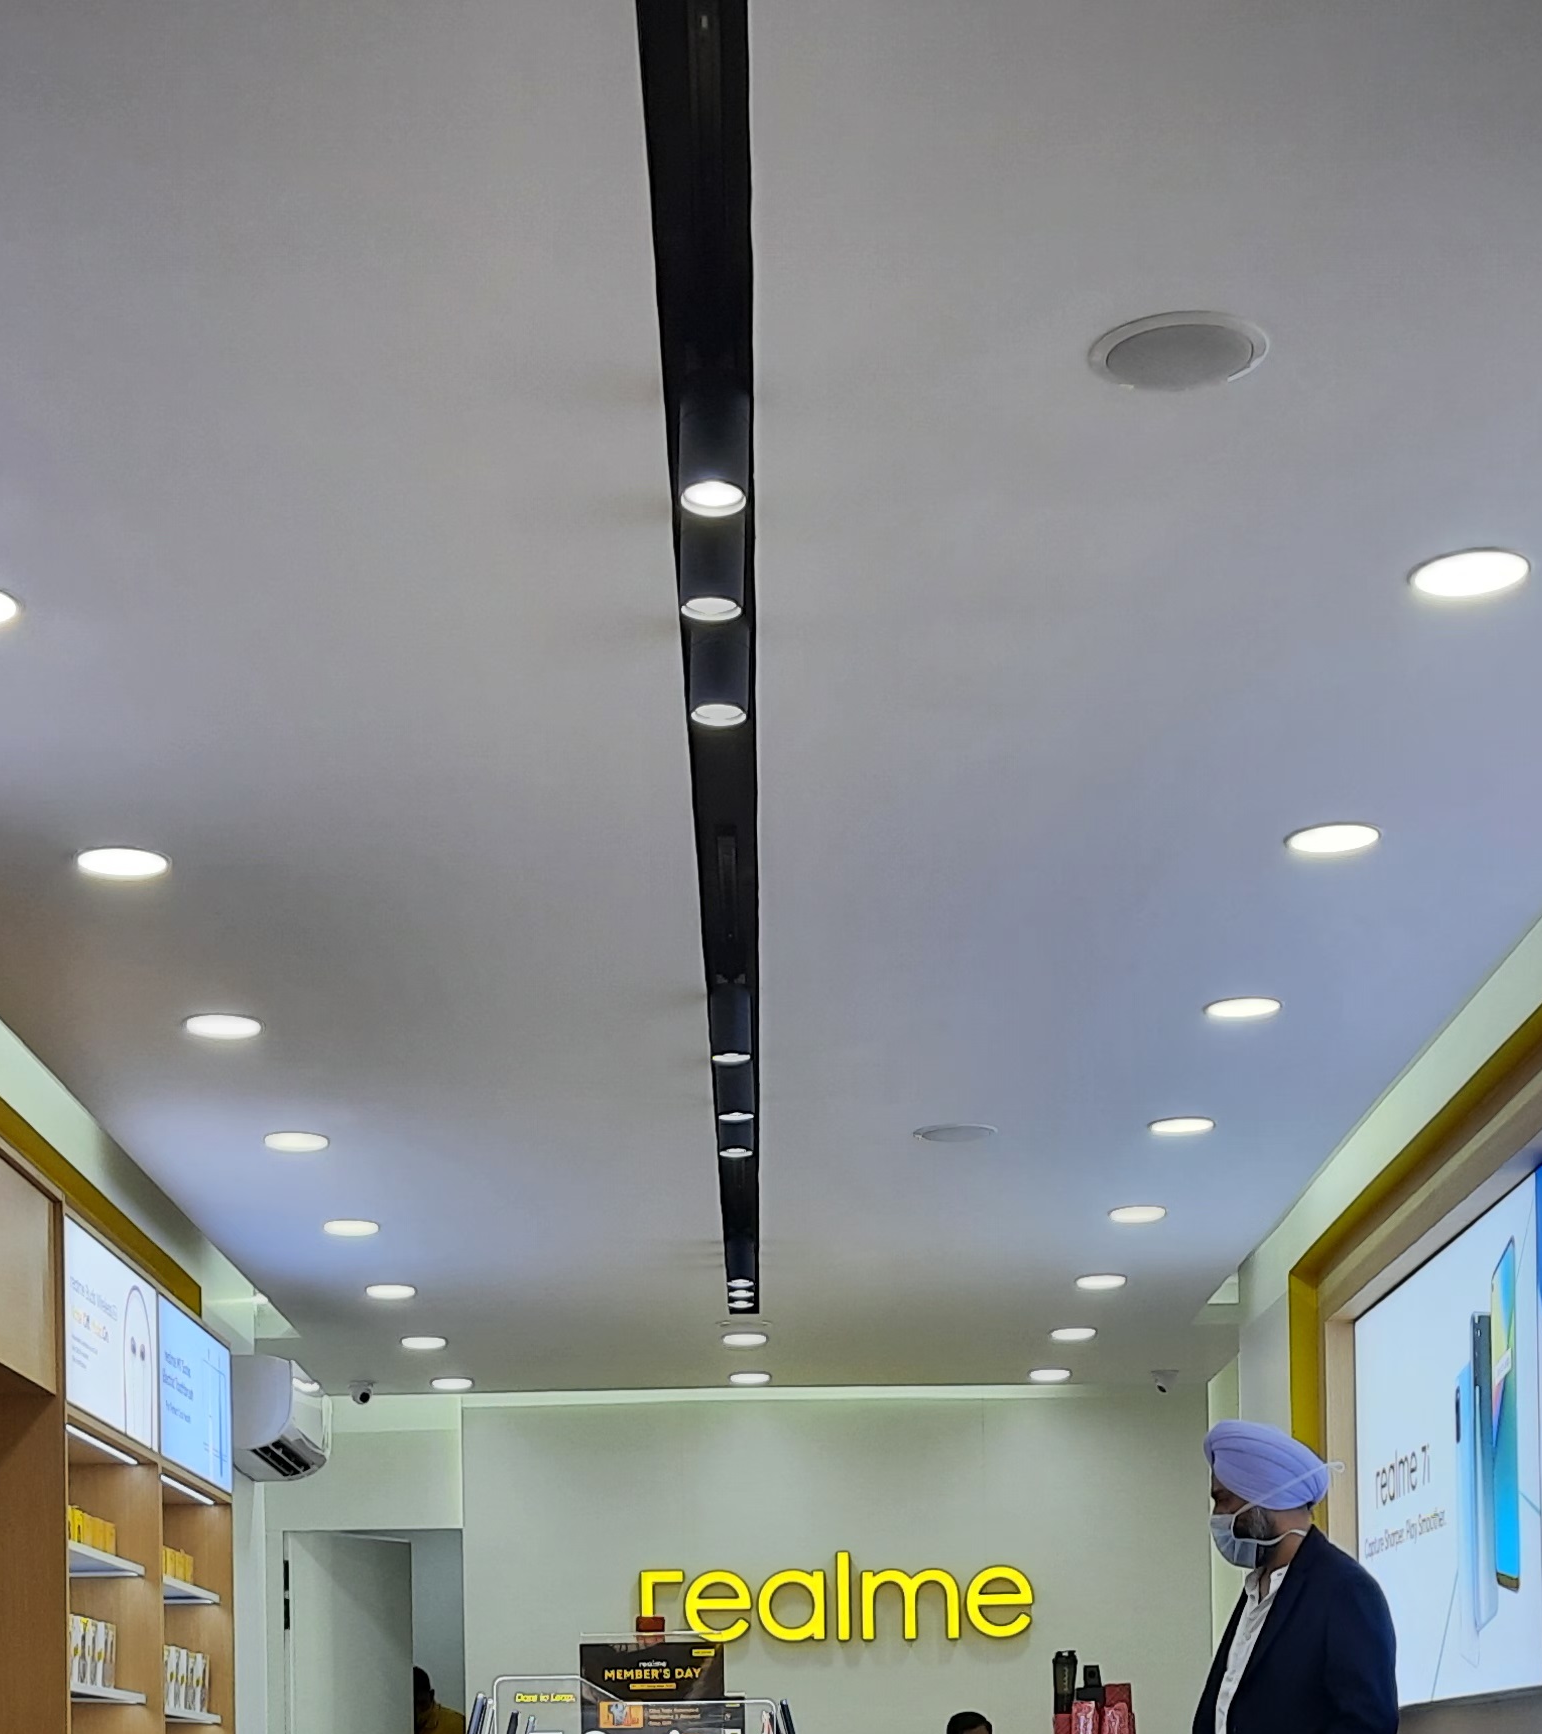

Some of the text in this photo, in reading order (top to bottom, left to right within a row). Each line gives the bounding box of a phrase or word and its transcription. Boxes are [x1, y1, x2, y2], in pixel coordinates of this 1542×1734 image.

[1375, 1442, 1431, 1510] realme 7i
[639, 1550, 1035, 1642] realme
[603, 1666, 703, 1682] MEMBER'S DAY
